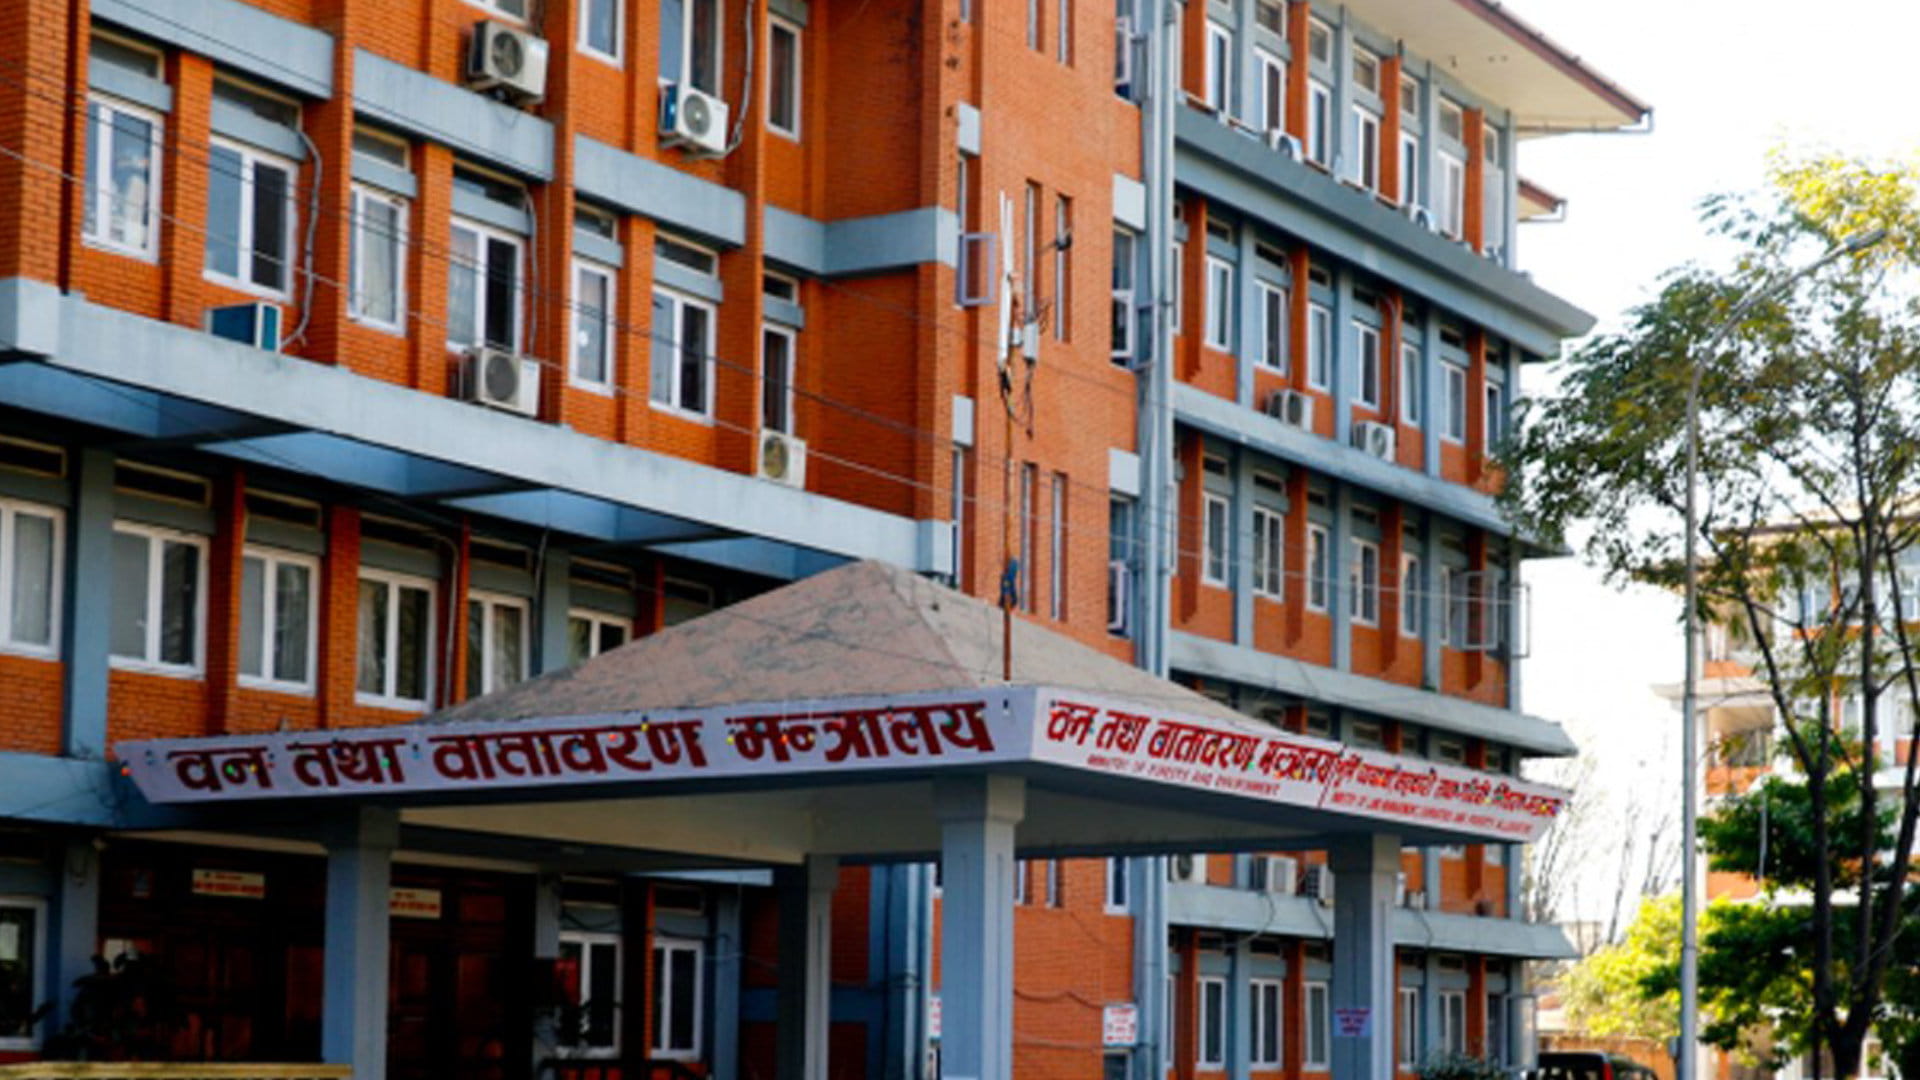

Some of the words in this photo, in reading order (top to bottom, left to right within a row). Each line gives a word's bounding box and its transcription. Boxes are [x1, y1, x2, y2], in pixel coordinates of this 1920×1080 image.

[167, 744, 272, 792] वन
[286, 737, 406, 788] तथा
[427, 719, 708, 783] वातावरण
[725, 701, 995, 762] मन्त्रालय
[1047, 700, 1098, 746] वन
[1096, 710, 1151, 754] तथा
[1147, 720, 1261, 772] वातावरण
